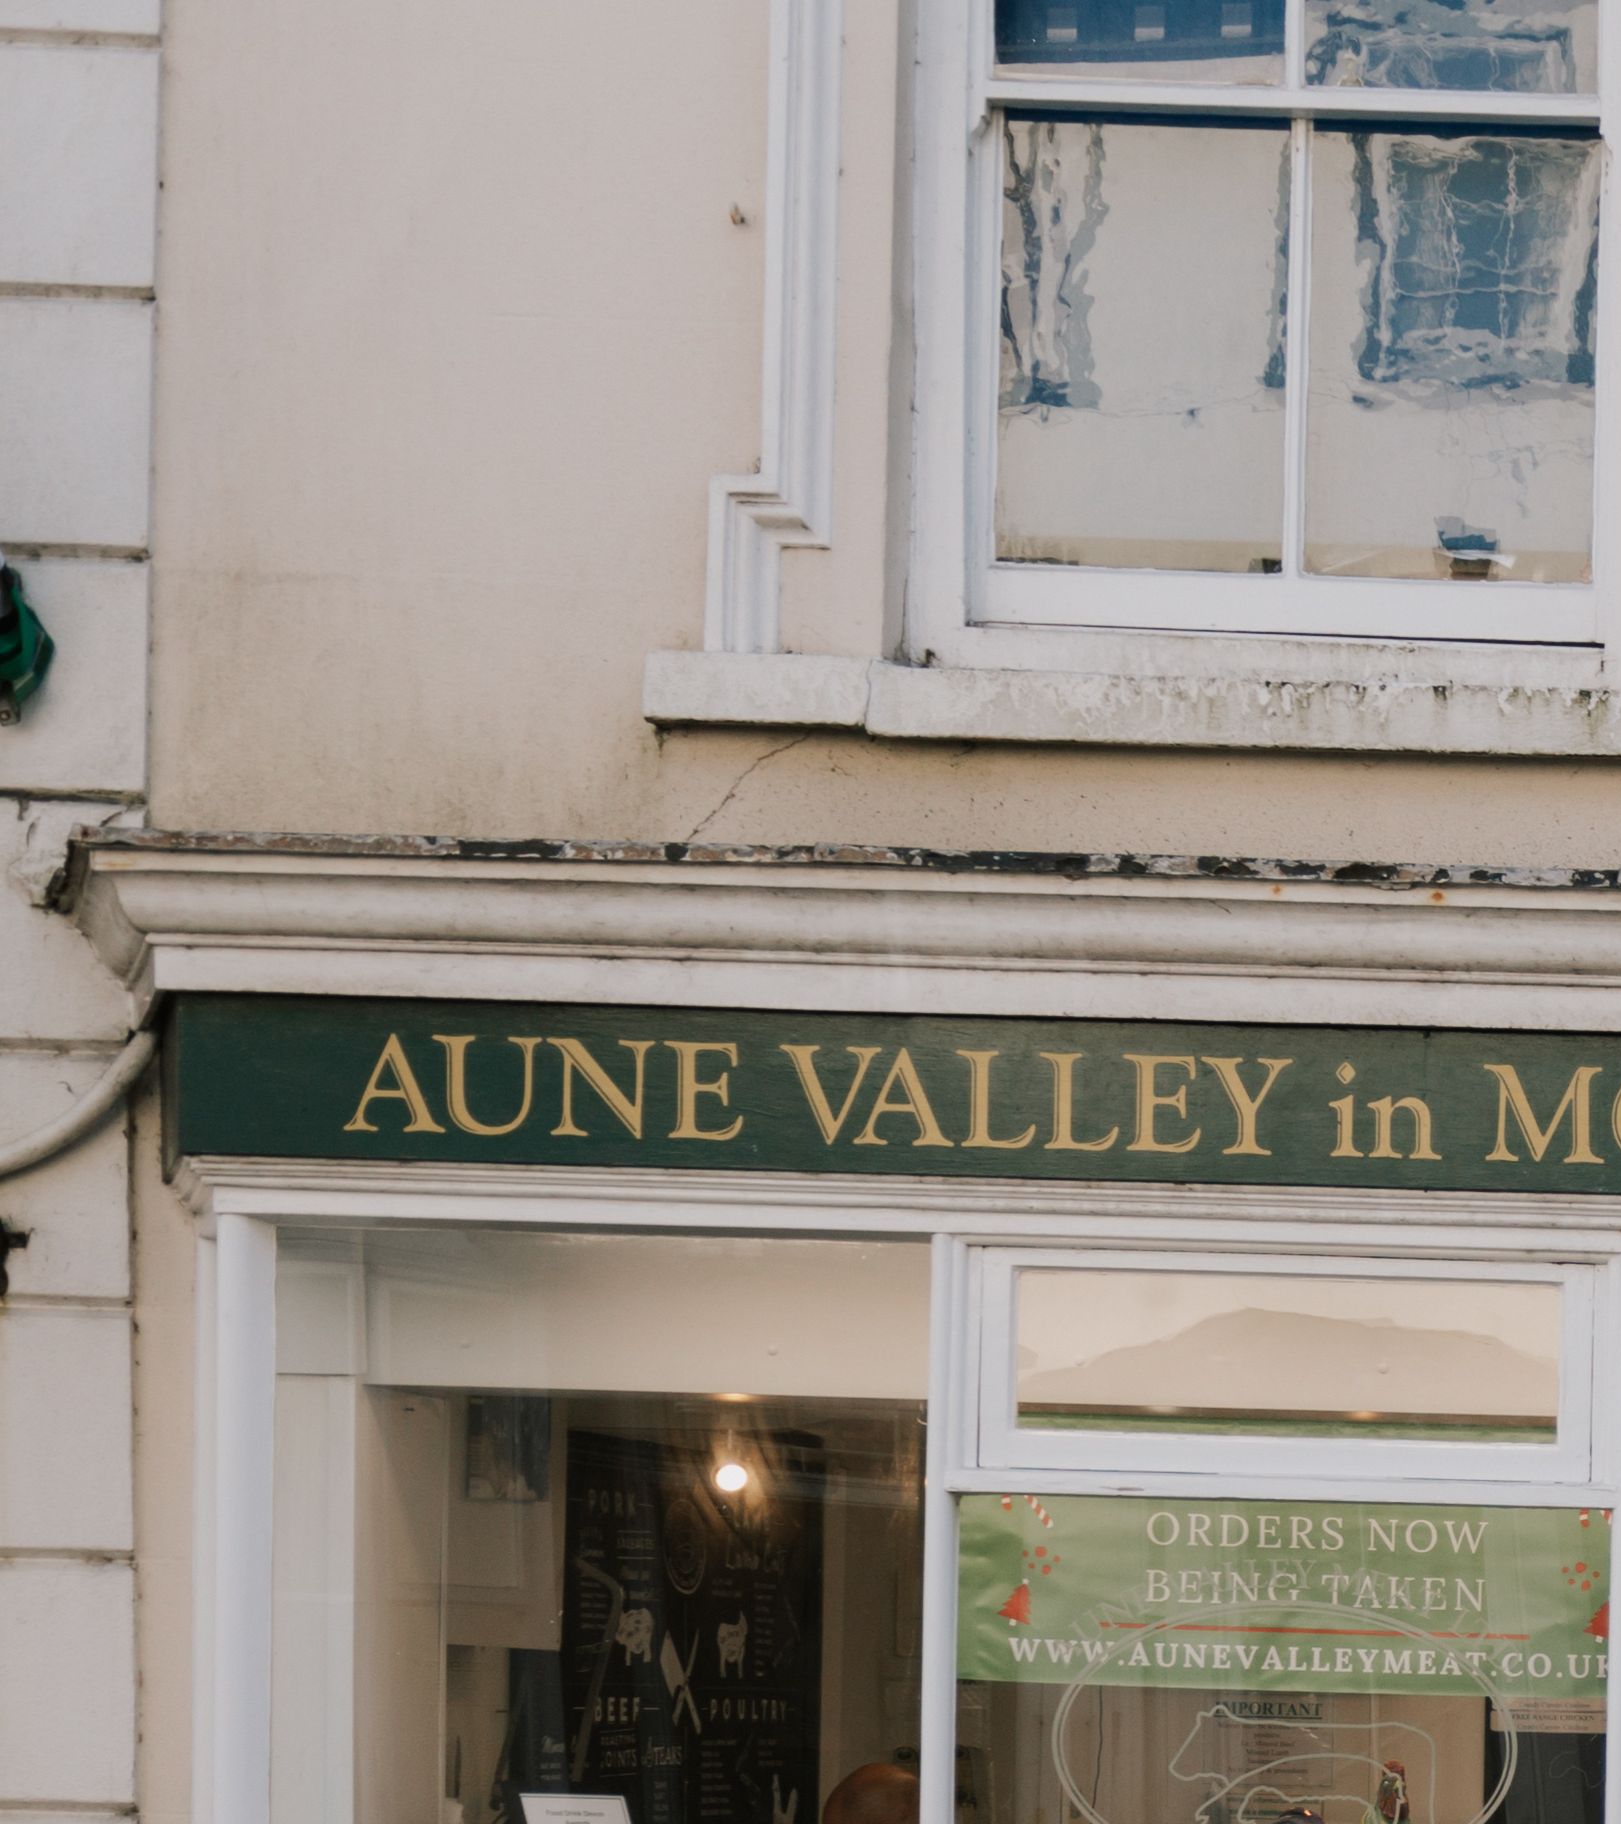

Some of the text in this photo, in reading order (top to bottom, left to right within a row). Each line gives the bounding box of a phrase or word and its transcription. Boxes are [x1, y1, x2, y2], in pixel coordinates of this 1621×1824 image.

[342, 1032, 744, 1142] AUNE
[779, 1044, 1293, 1156] VALLEY
[1328, 1060, 1443, 1163] in
[1146, 1510, 1490, 1555] ORDERS NOW
[1145, 1568, 1487, 1612] BEING TAKEN
[710, 1698, 787, 1721] POULTRY
[1213, 1701, 1324, 1719] IMPORTANT
